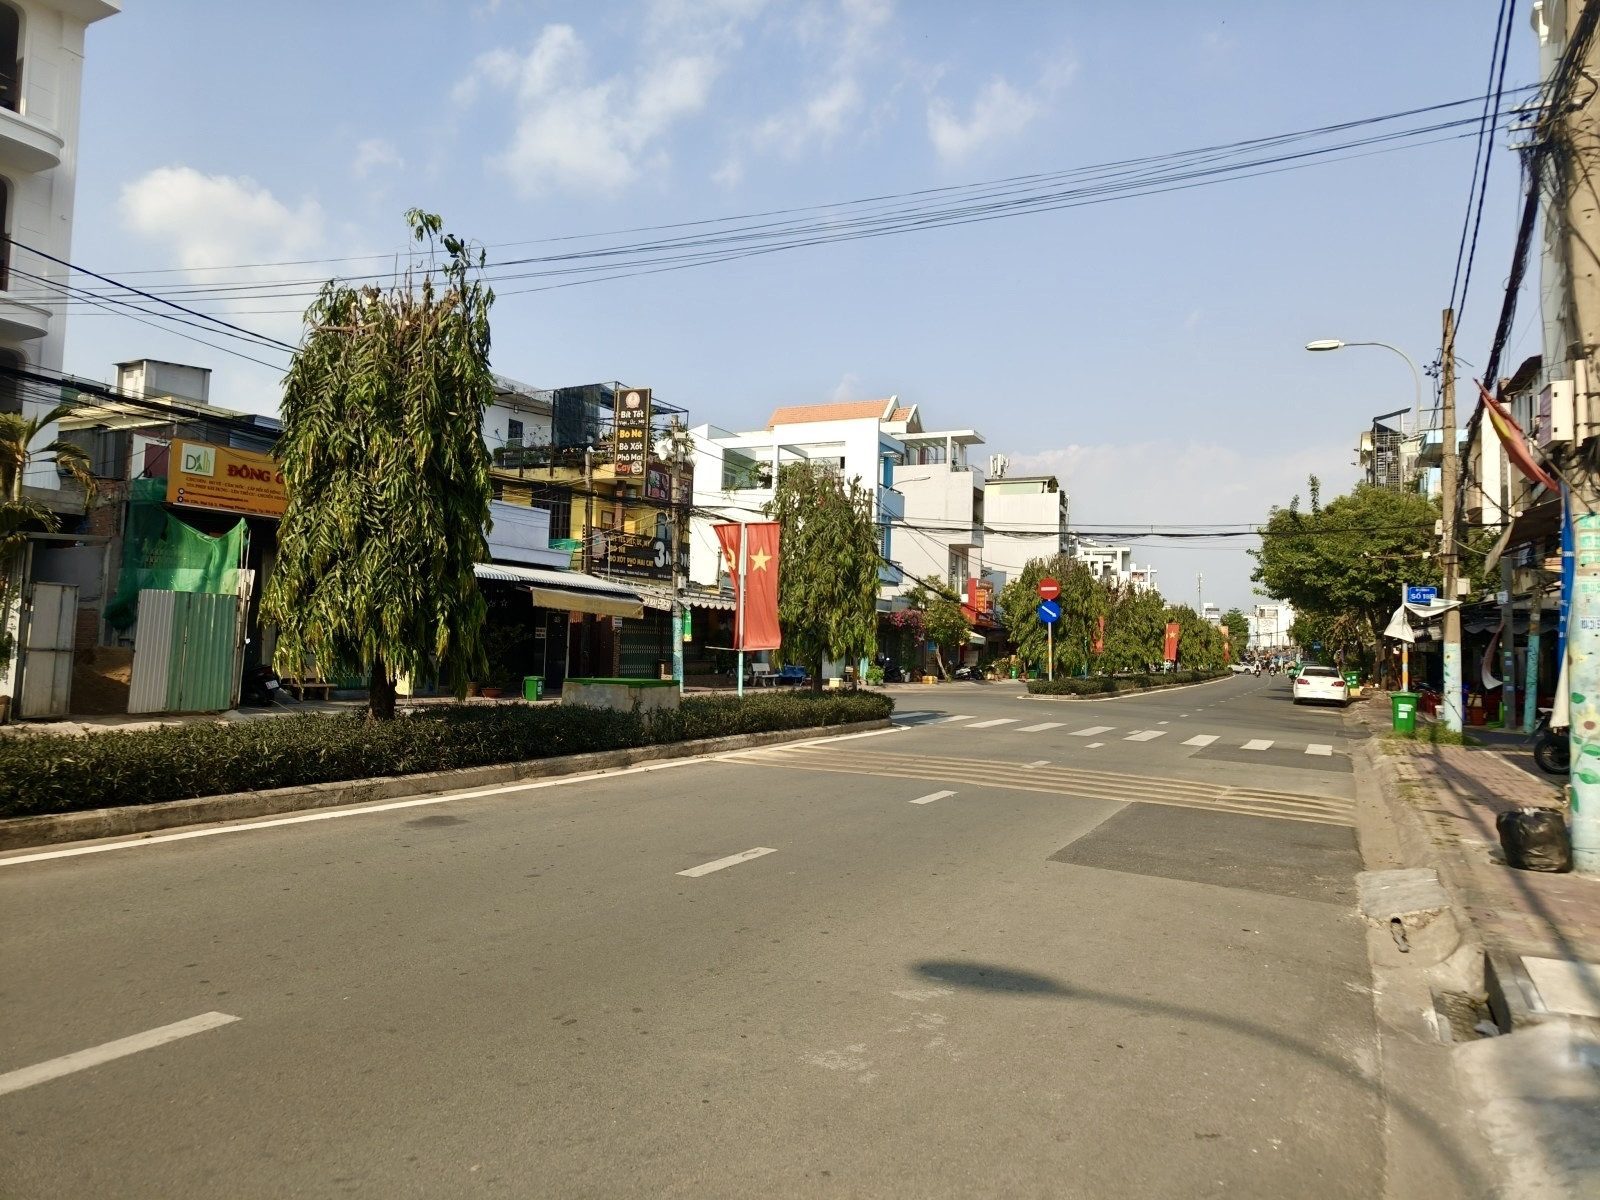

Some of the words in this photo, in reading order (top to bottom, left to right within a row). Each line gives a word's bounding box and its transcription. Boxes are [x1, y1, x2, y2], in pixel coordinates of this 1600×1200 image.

[631, 453, 643, 461] Mai
[616, 462, 632, 473] Cay
[1411, 592, 1421, 600] SỐ
